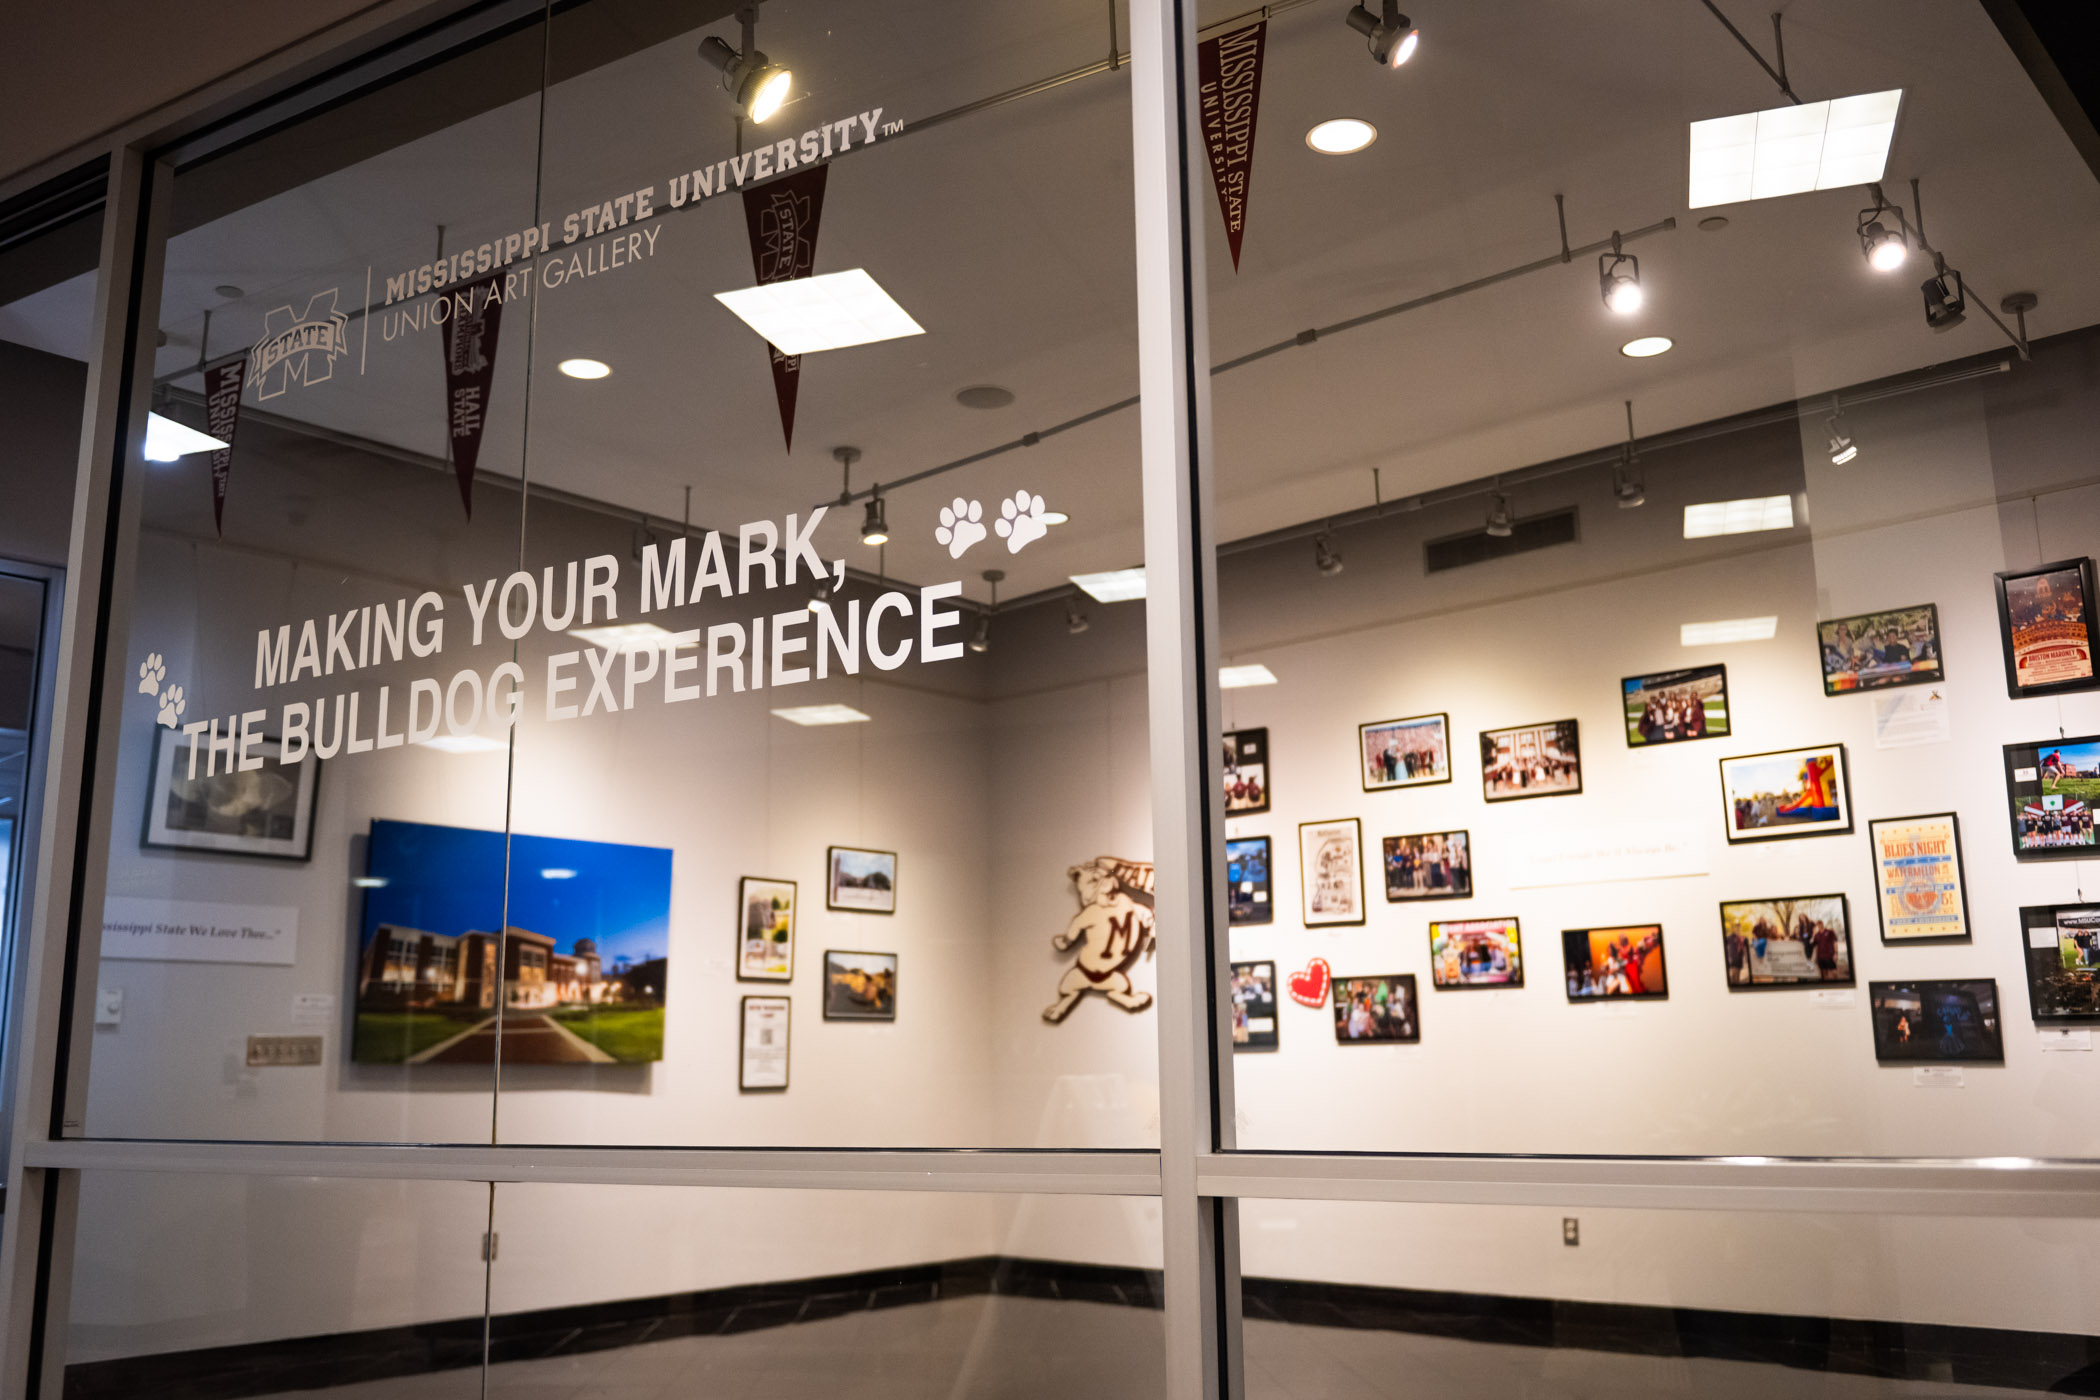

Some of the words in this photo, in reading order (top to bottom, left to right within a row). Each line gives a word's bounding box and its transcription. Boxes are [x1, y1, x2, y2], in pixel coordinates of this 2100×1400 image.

[1200, 80, 1227, 196] UNIVERSITY
[1218, 24, 1260, 168] MISSISSIPPI
[385, 222, 550, 305] MISSISSIPPI
[563, 186, 654, 244] STATE
[669, 107, 883, 208] UNIVERSITY
[779, 208, 795, 269] STATE
[1227, 170, 1245, 233] STATE
[383, 287, 474, 341] UNION
[483, 266, 533, 310] ART
[542, 224, 661, 289] GALLERY
[267, 325, 329, 361] STATE
[208, 393, 223, 478] UNIVSITY
[218, 361, 243, 468] MISSISSPPI
[453, 388, 465, 438] STATE
[466, 386, 481, 436] HAIL
[254, 591, 445, 689] MAKING
[463, 554, 619, 646] YOUR
[640, 506, 846, 614] MARK,
[183, 709, 267, 781] THE
[280, 661, 525, 766] BULLDOG
[546, 580, 964, 722] EXPERIENCE
[1884, 841, 1915, 858] BLUES
[1916, 839, 1947, 856] NIGHT
[1101, 911, 1133, 959] M
